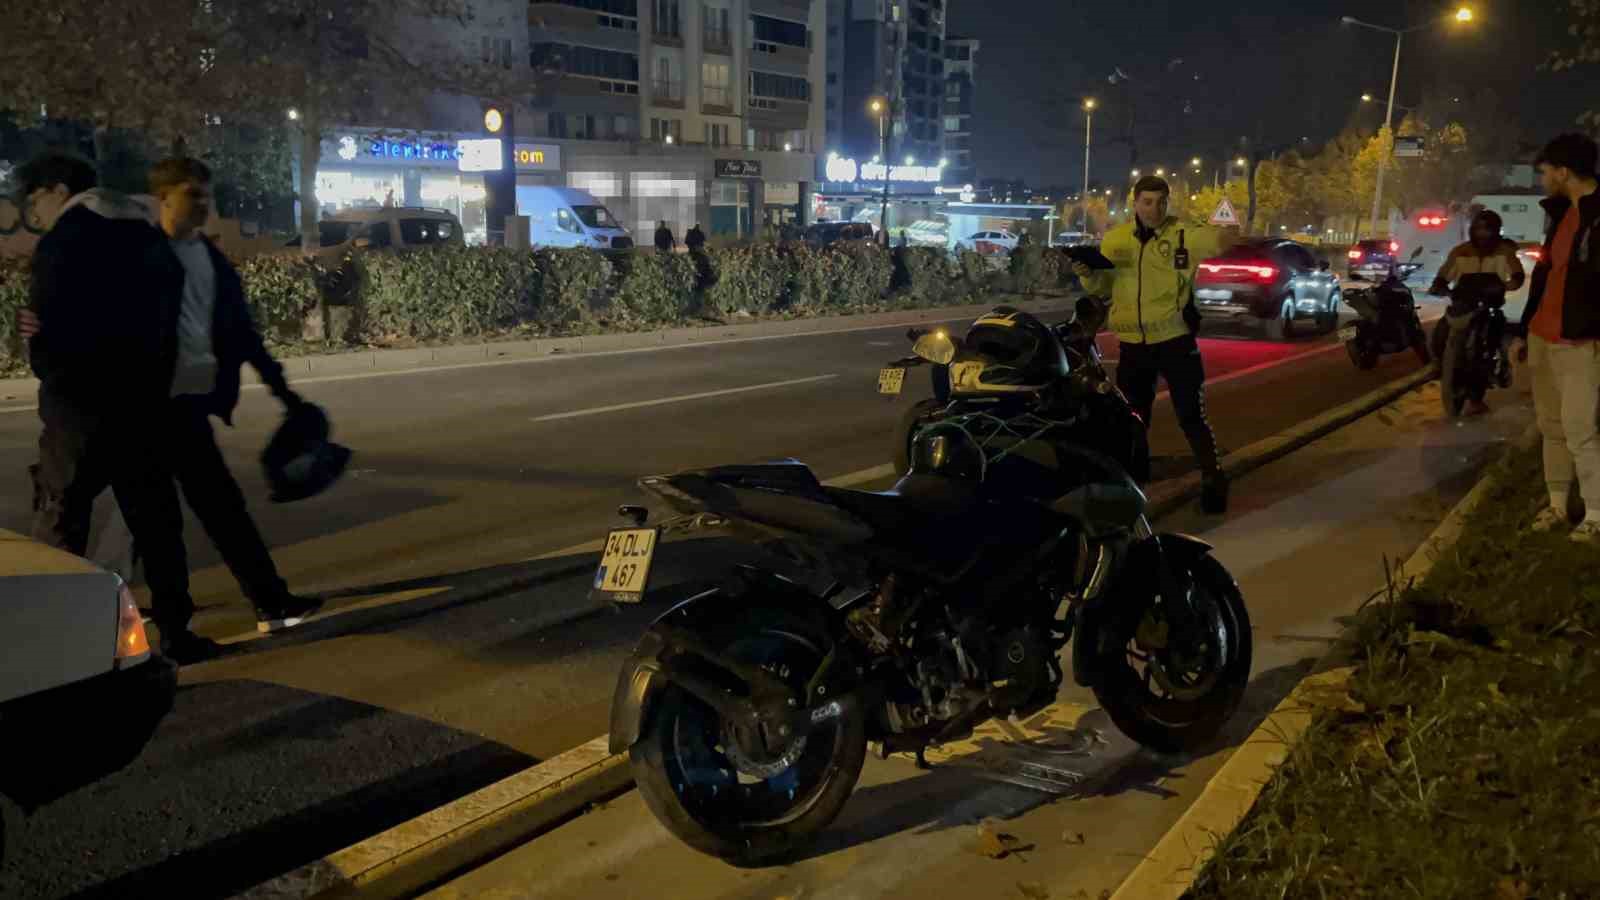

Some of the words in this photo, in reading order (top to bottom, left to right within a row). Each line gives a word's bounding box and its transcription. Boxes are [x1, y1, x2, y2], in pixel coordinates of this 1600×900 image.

[606, 534, 622, 556] 34
[622, 533, 652, 557] DLJ
[611, 562, 637, 587] 467
